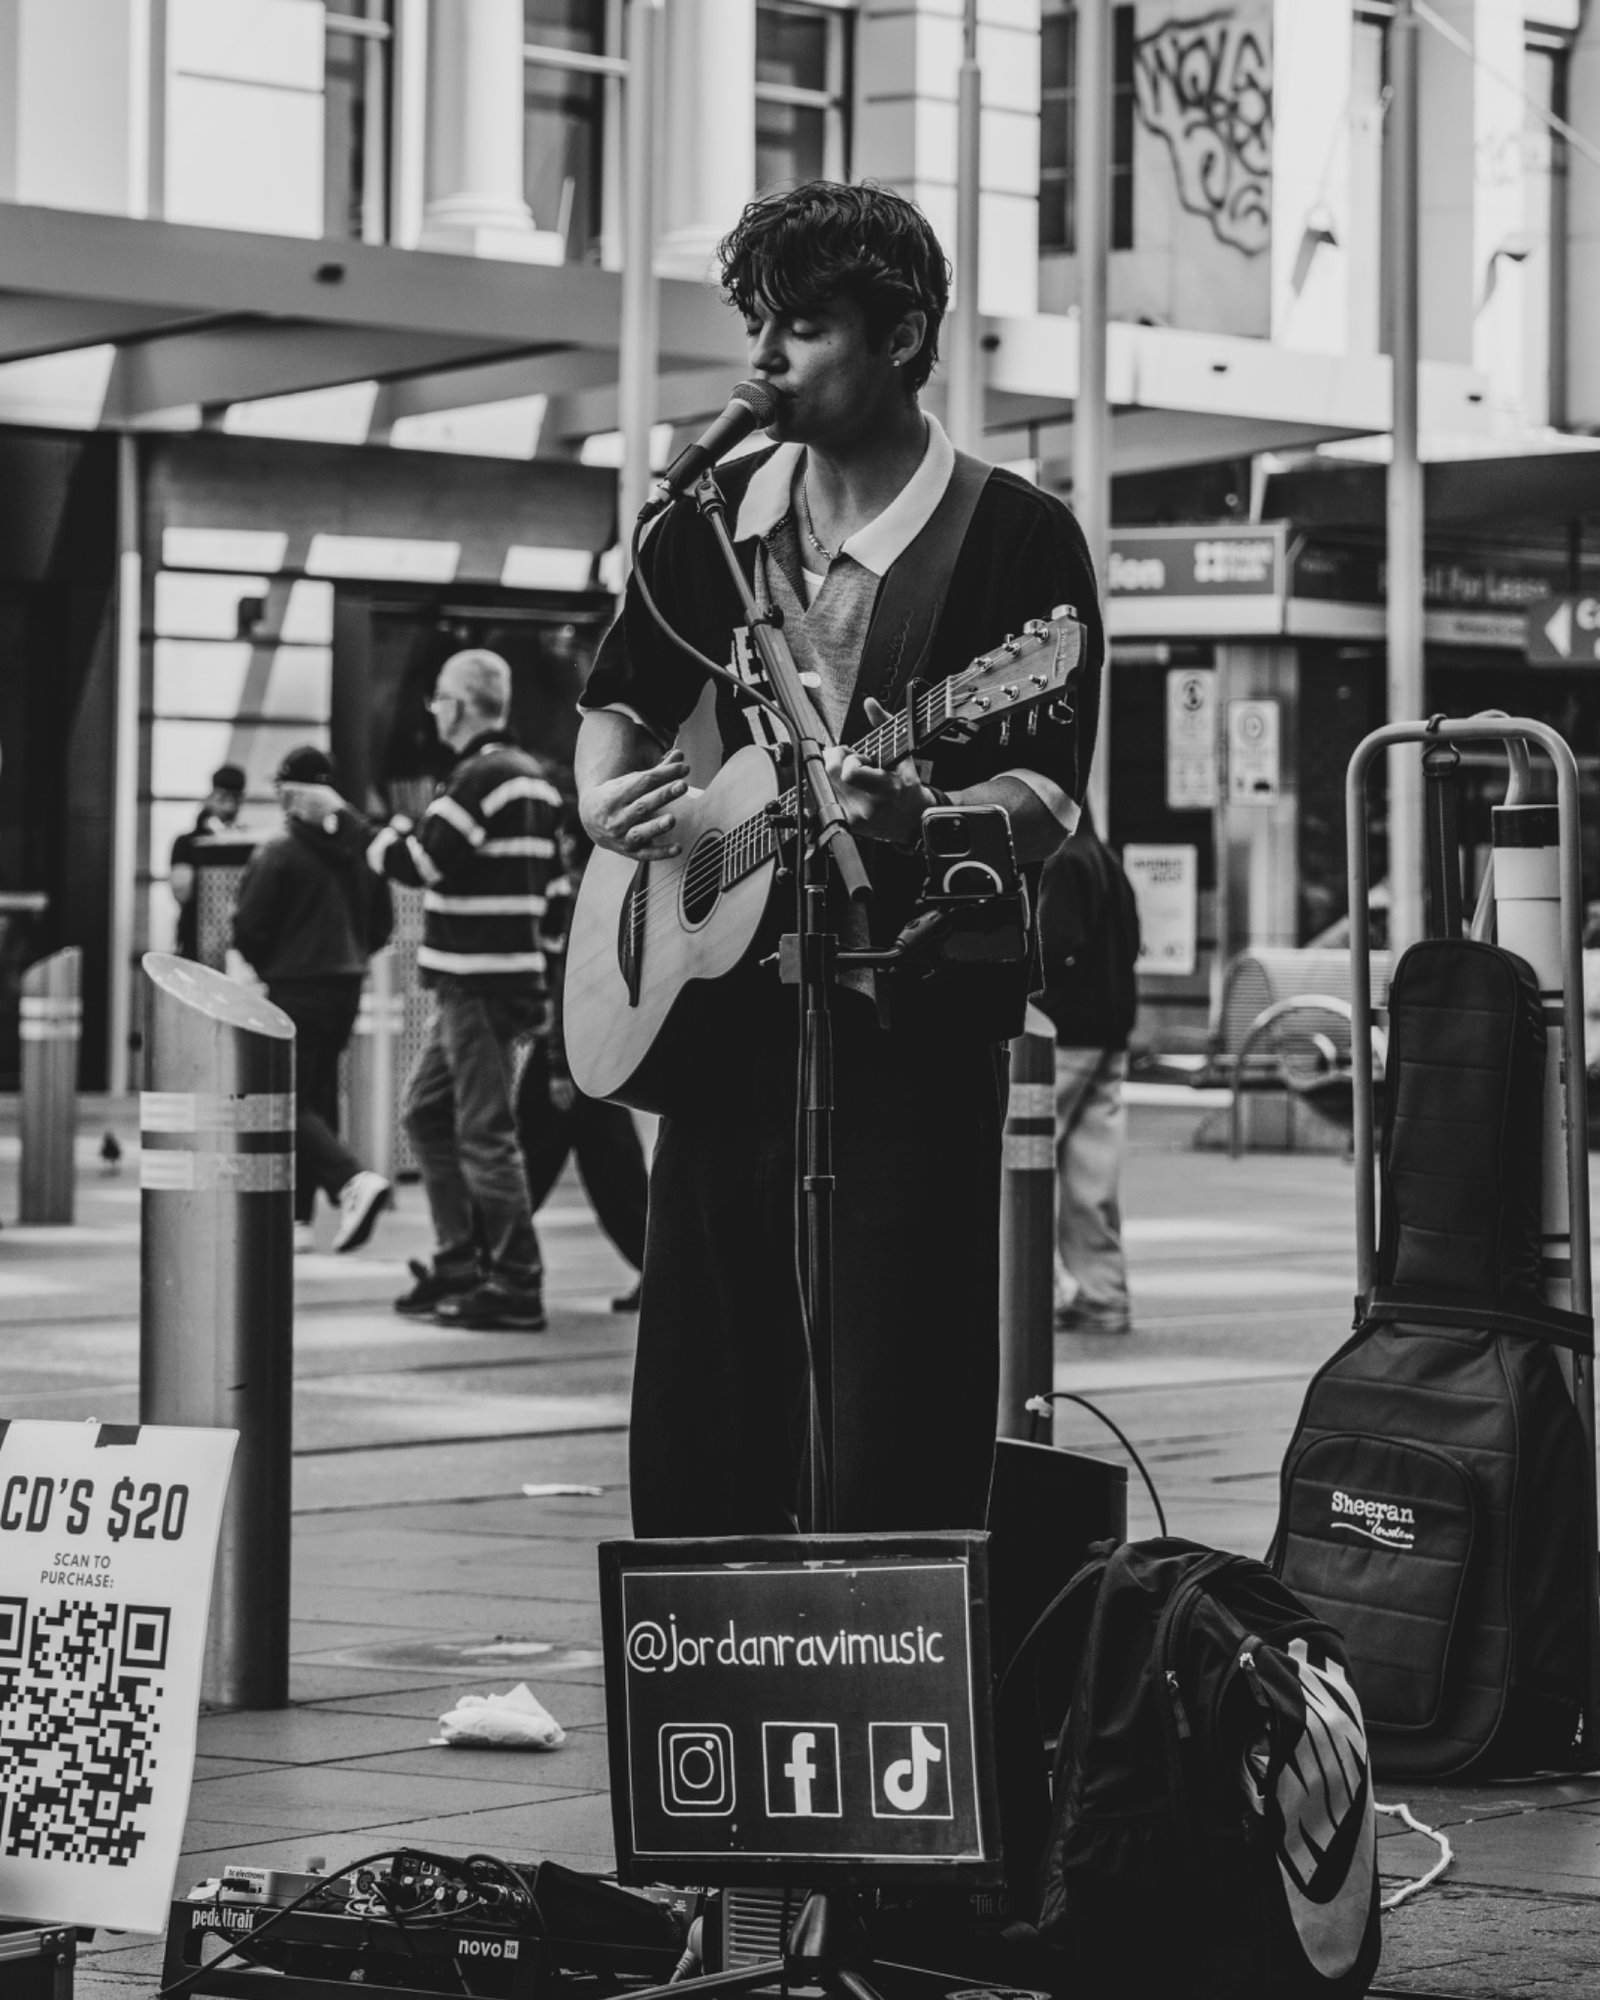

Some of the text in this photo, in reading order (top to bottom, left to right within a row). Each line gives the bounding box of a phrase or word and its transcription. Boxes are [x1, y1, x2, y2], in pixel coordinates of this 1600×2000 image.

[0, 1475, 189, 1542] CD'S $20
[1331, 1490, 1415, 1524] Sheeran
[53, 1552, 111, 1569] SCAN TO
[40, 1570, 114, 1588] PURCHASE:
[627, 1613, 944, 1672] @jordanravimusic
[458, 1939, 502, 1957] novo
